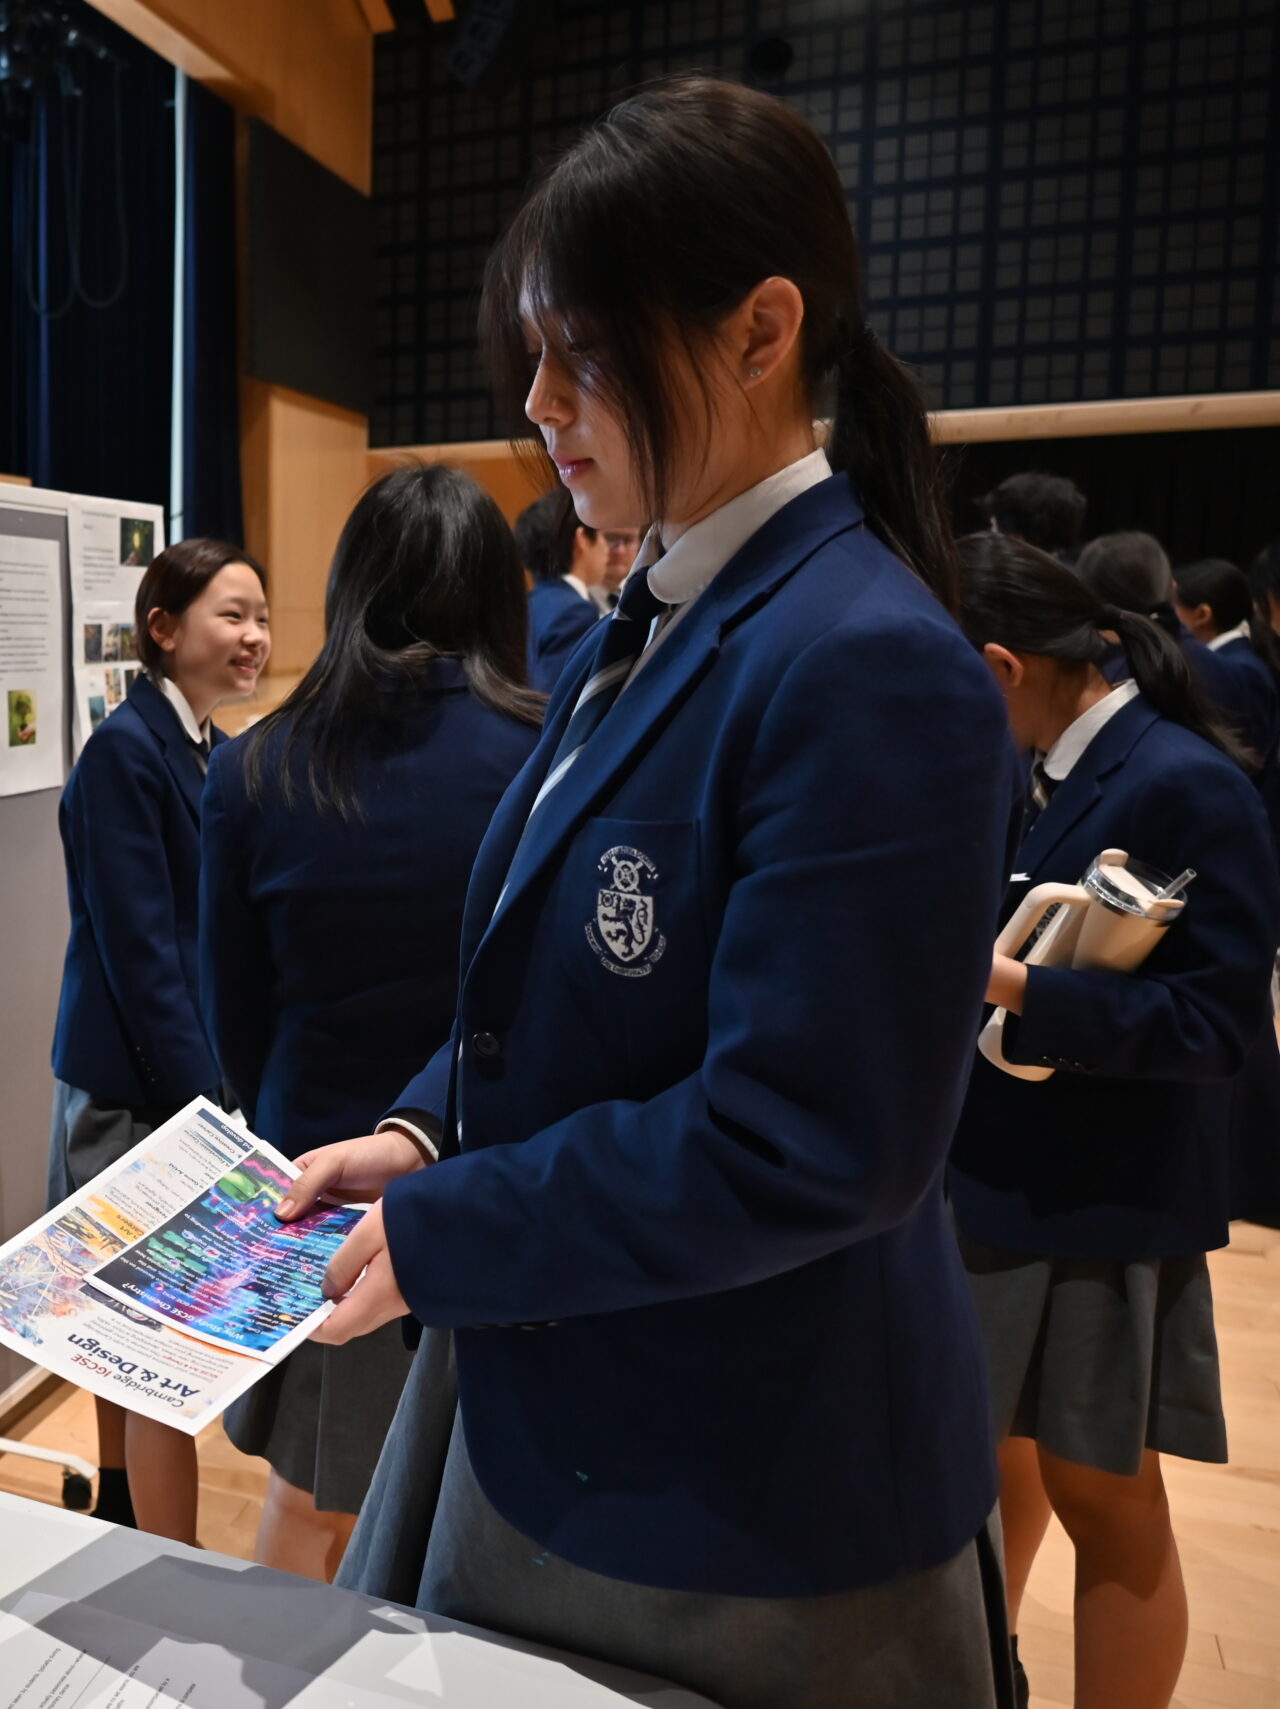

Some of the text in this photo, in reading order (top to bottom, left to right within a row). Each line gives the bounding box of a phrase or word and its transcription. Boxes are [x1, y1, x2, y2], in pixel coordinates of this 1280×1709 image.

[219, 1124, 244, 1143] develop
[115, 1214, 144, 1235] Careers
[118, 1225, 132, 1236] Art
[119, 1281, 245, 1340] Why Study GCSE Chemistry?
[68, 1335, 199, 1396] Art & Design
[72, 1355, 183, 1406] Cambridge IGCSE
